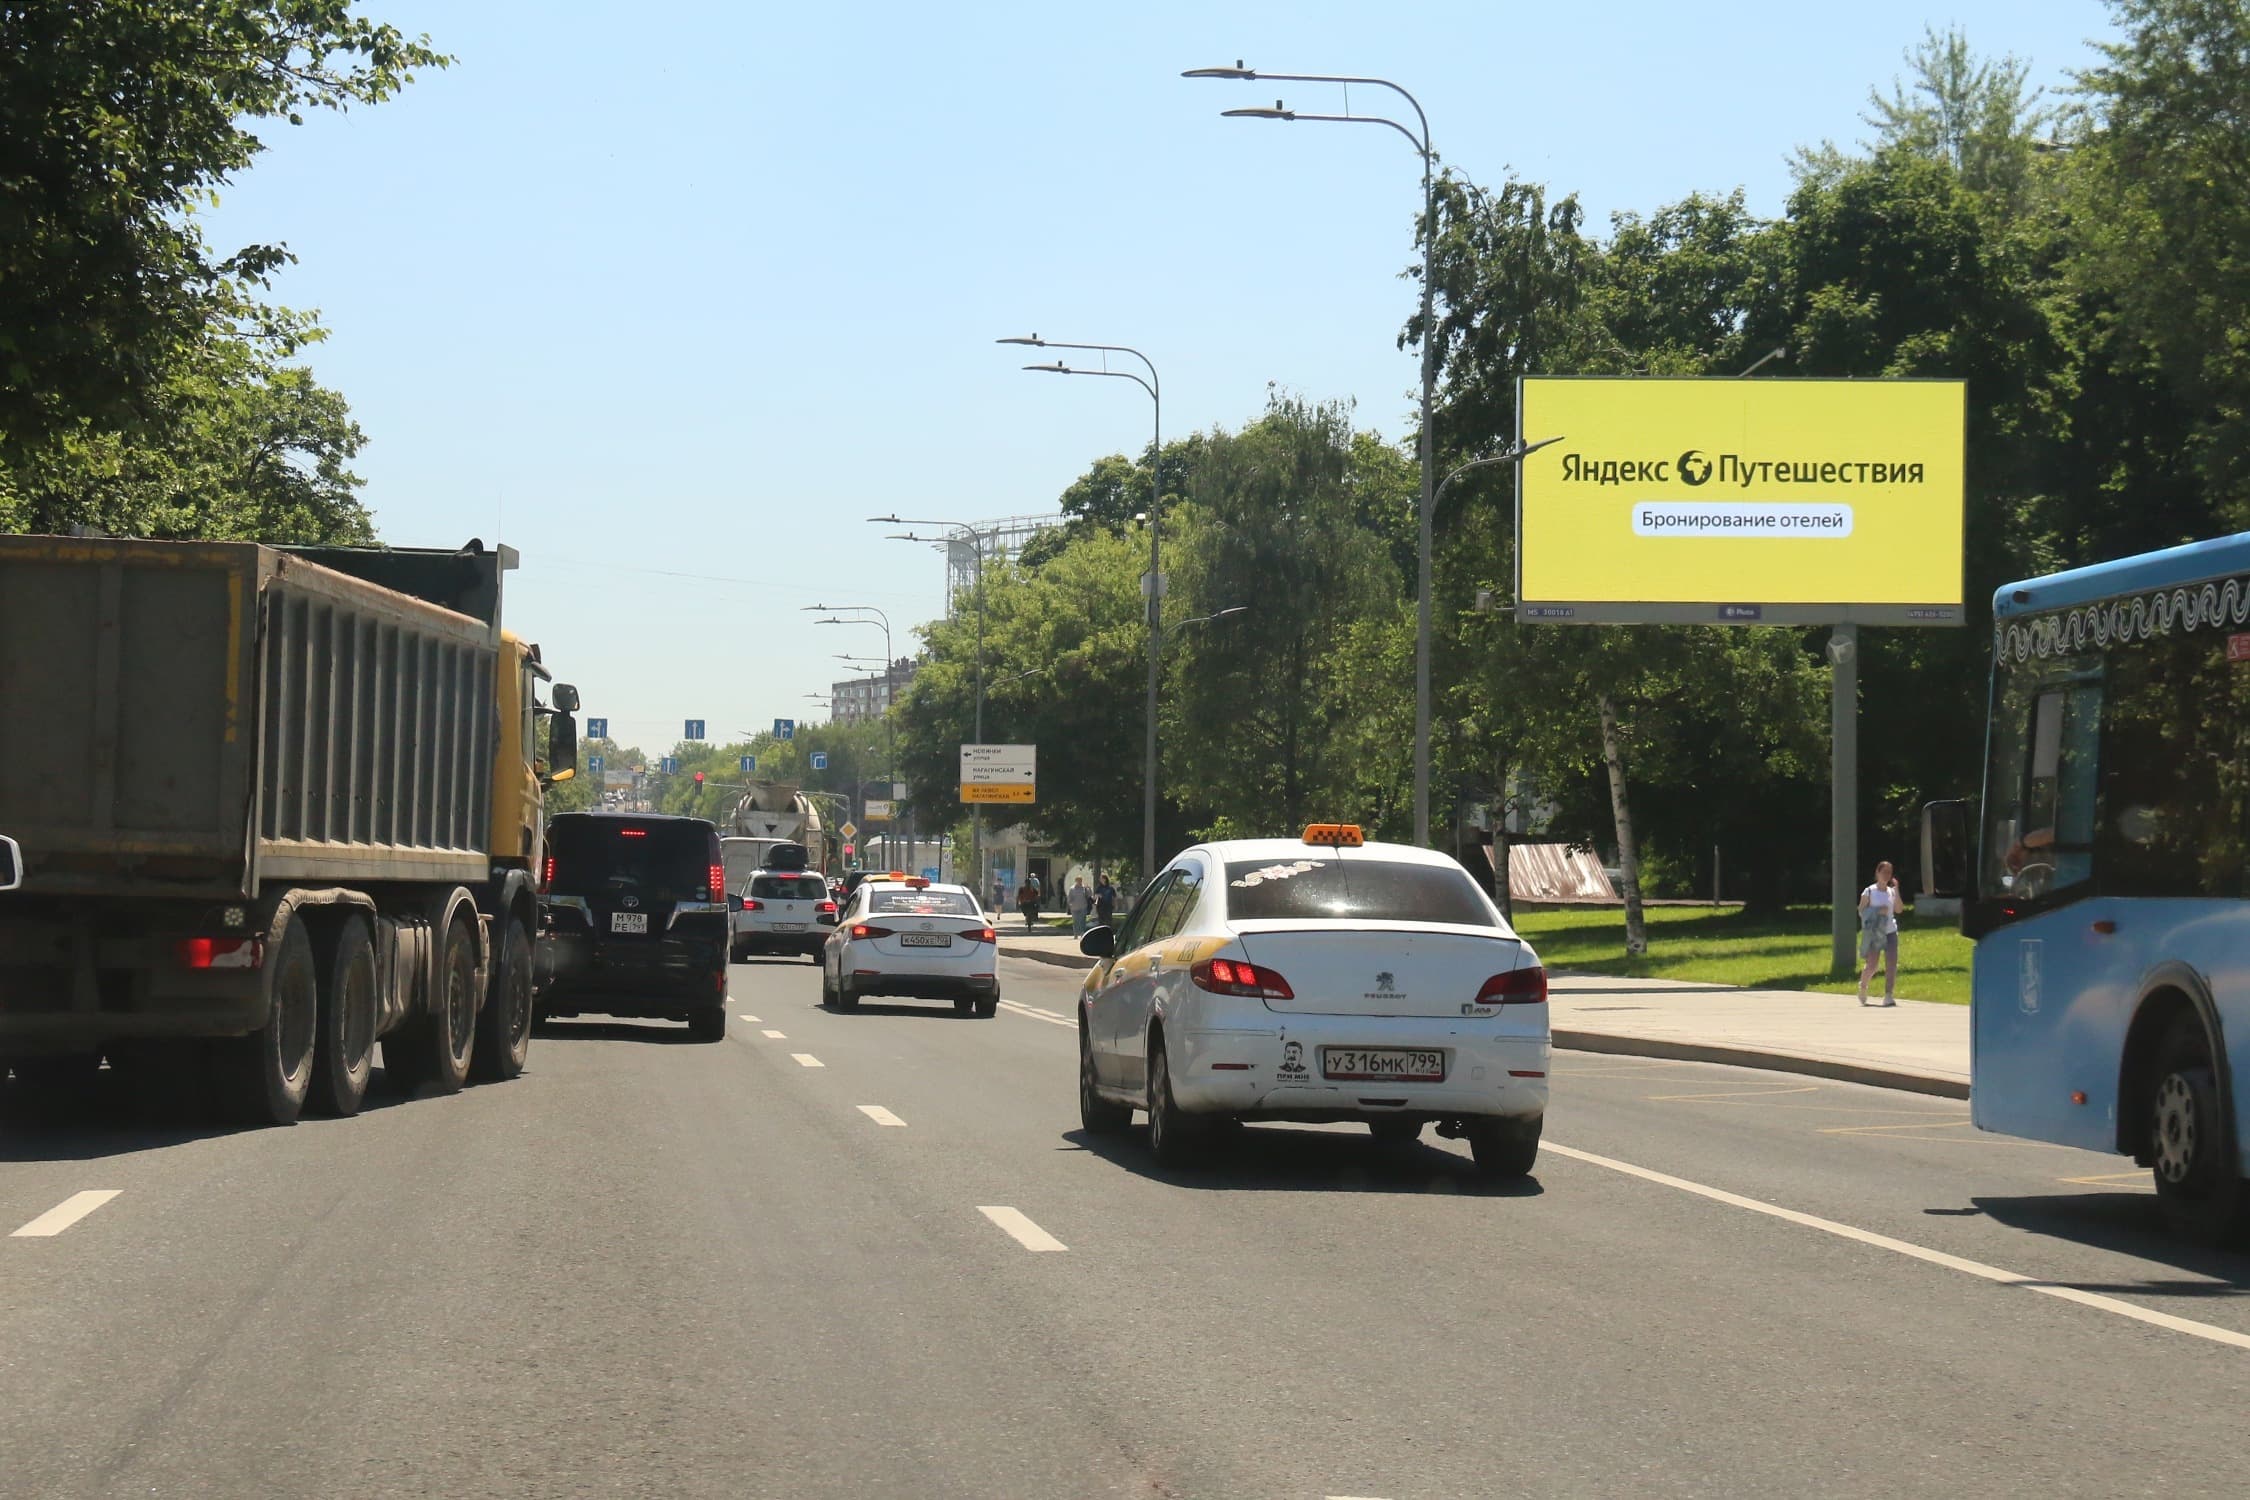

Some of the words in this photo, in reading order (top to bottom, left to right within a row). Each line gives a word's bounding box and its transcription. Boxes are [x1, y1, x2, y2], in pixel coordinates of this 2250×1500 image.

[1561, 454, 1669, 486] Яндекс
[1719, 454, 1925, 488] Путешествия
[1642, 510, 1776, 530] Бронирование
[1780, 510, 1844, 529] отелей
[1331, 1052, 1405, 1073] У316МК
